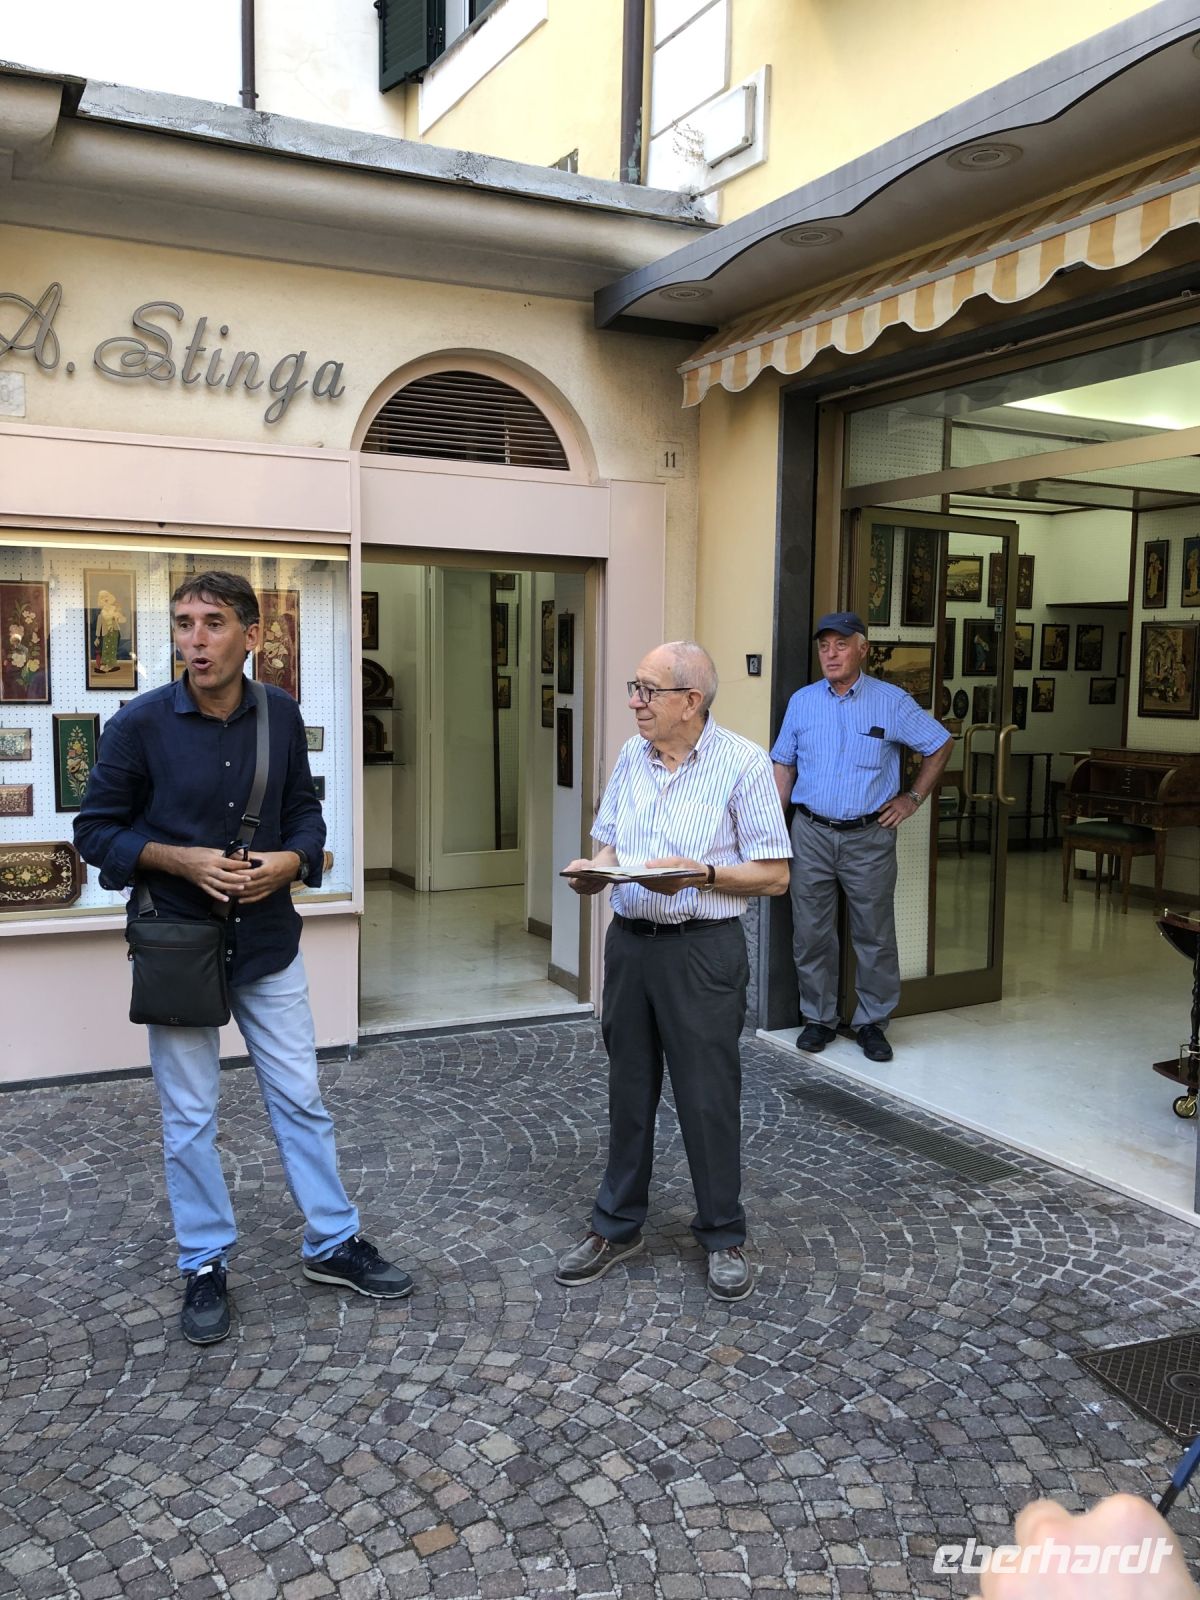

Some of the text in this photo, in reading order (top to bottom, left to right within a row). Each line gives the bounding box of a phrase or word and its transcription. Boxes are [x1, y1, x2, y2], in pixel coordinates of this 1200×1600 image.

[0, 282, 346, 423] A. Stinga
[664, 451, 676, 468] 11
